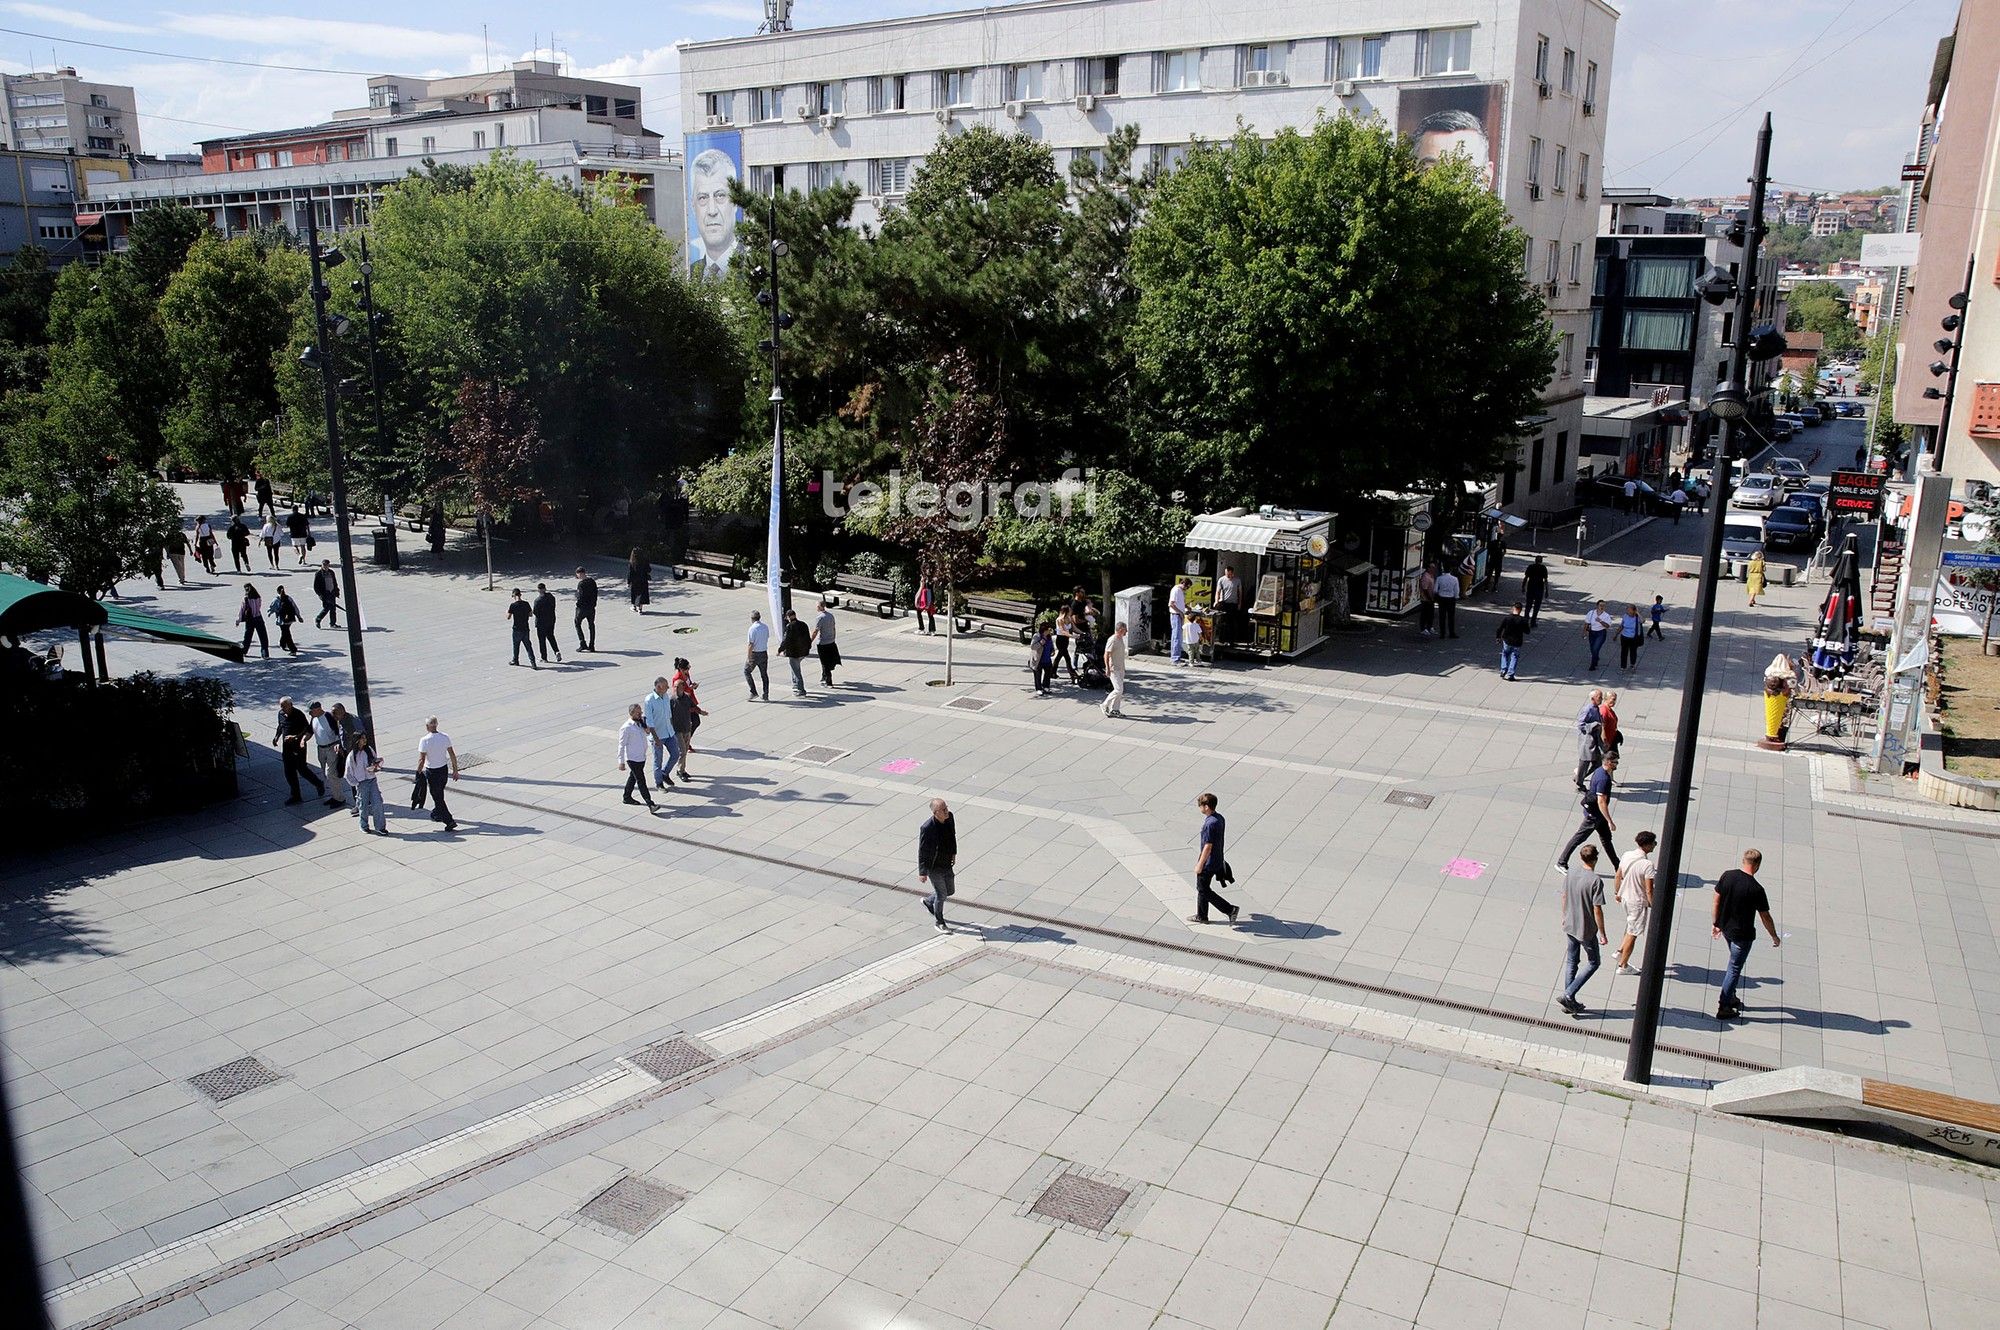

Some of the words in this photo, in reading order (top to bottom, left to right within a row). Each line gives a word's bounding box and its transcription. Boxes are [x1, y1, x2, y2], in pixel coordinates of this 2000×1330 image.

[1839, 474, 1879, 487] EAGLE
[1833, 486, 1859, 494] MOBILE
[1836, 498, 1874, 509] SERVICE
